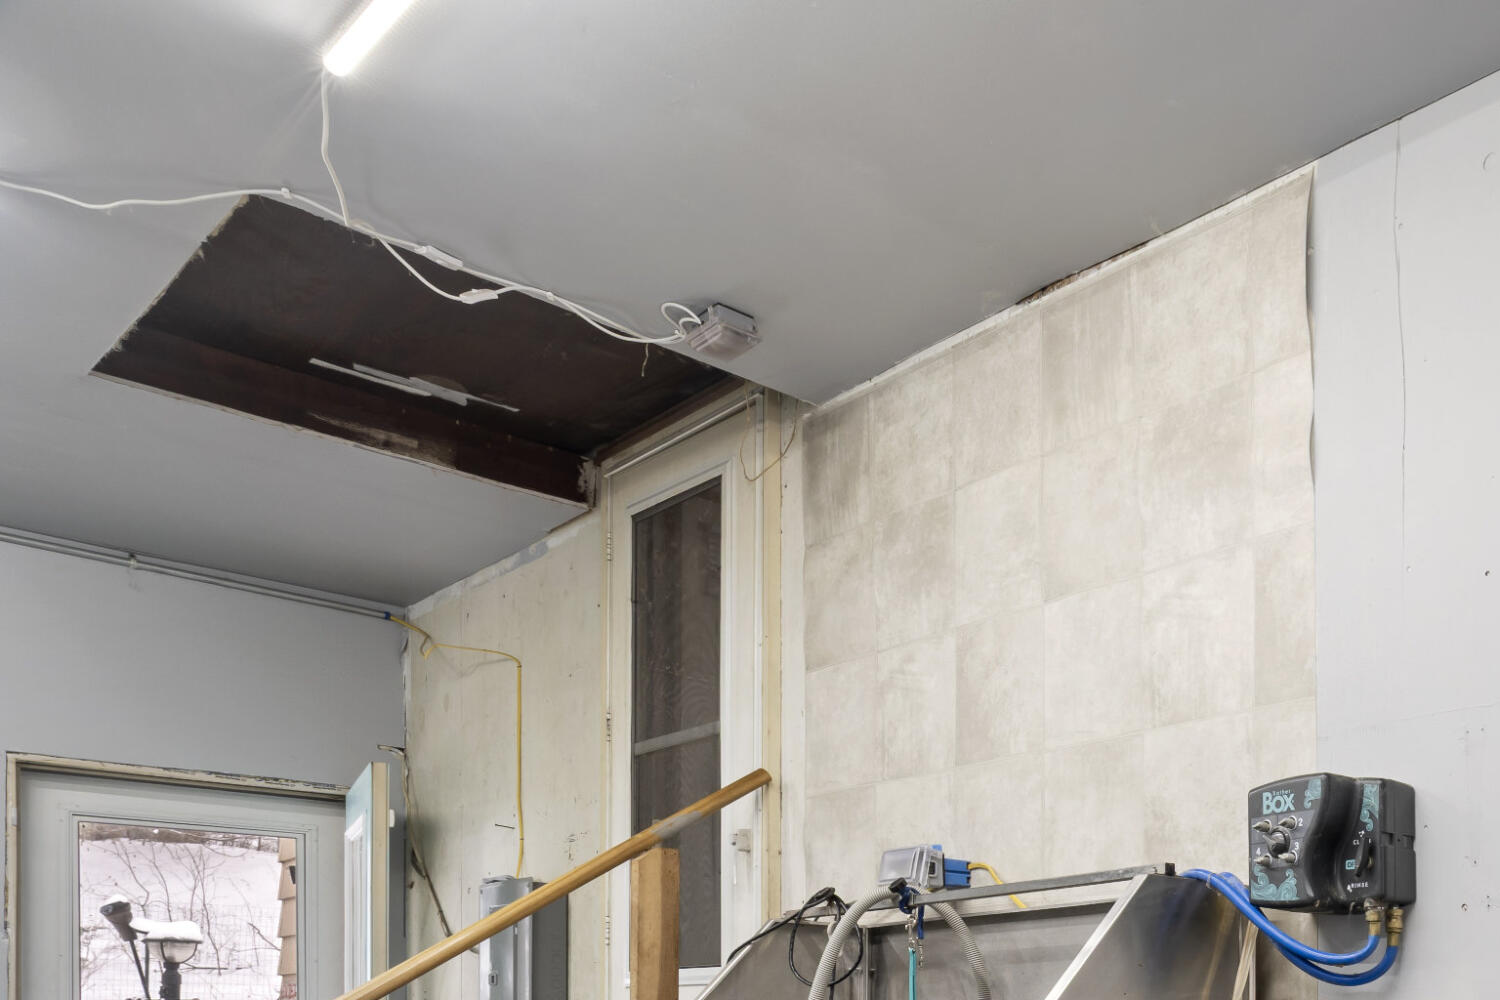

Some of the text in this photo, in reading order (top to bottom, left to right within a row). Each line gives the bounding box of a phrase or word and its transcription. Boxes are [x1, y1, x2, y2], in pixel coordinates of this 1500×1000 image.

[1263, 791, 1295, 815] BOX
[1298, 818, 1303, 827] 2
[1256, 847, 1261, 855] 4
[1294, 842, 1299, 851] 3
